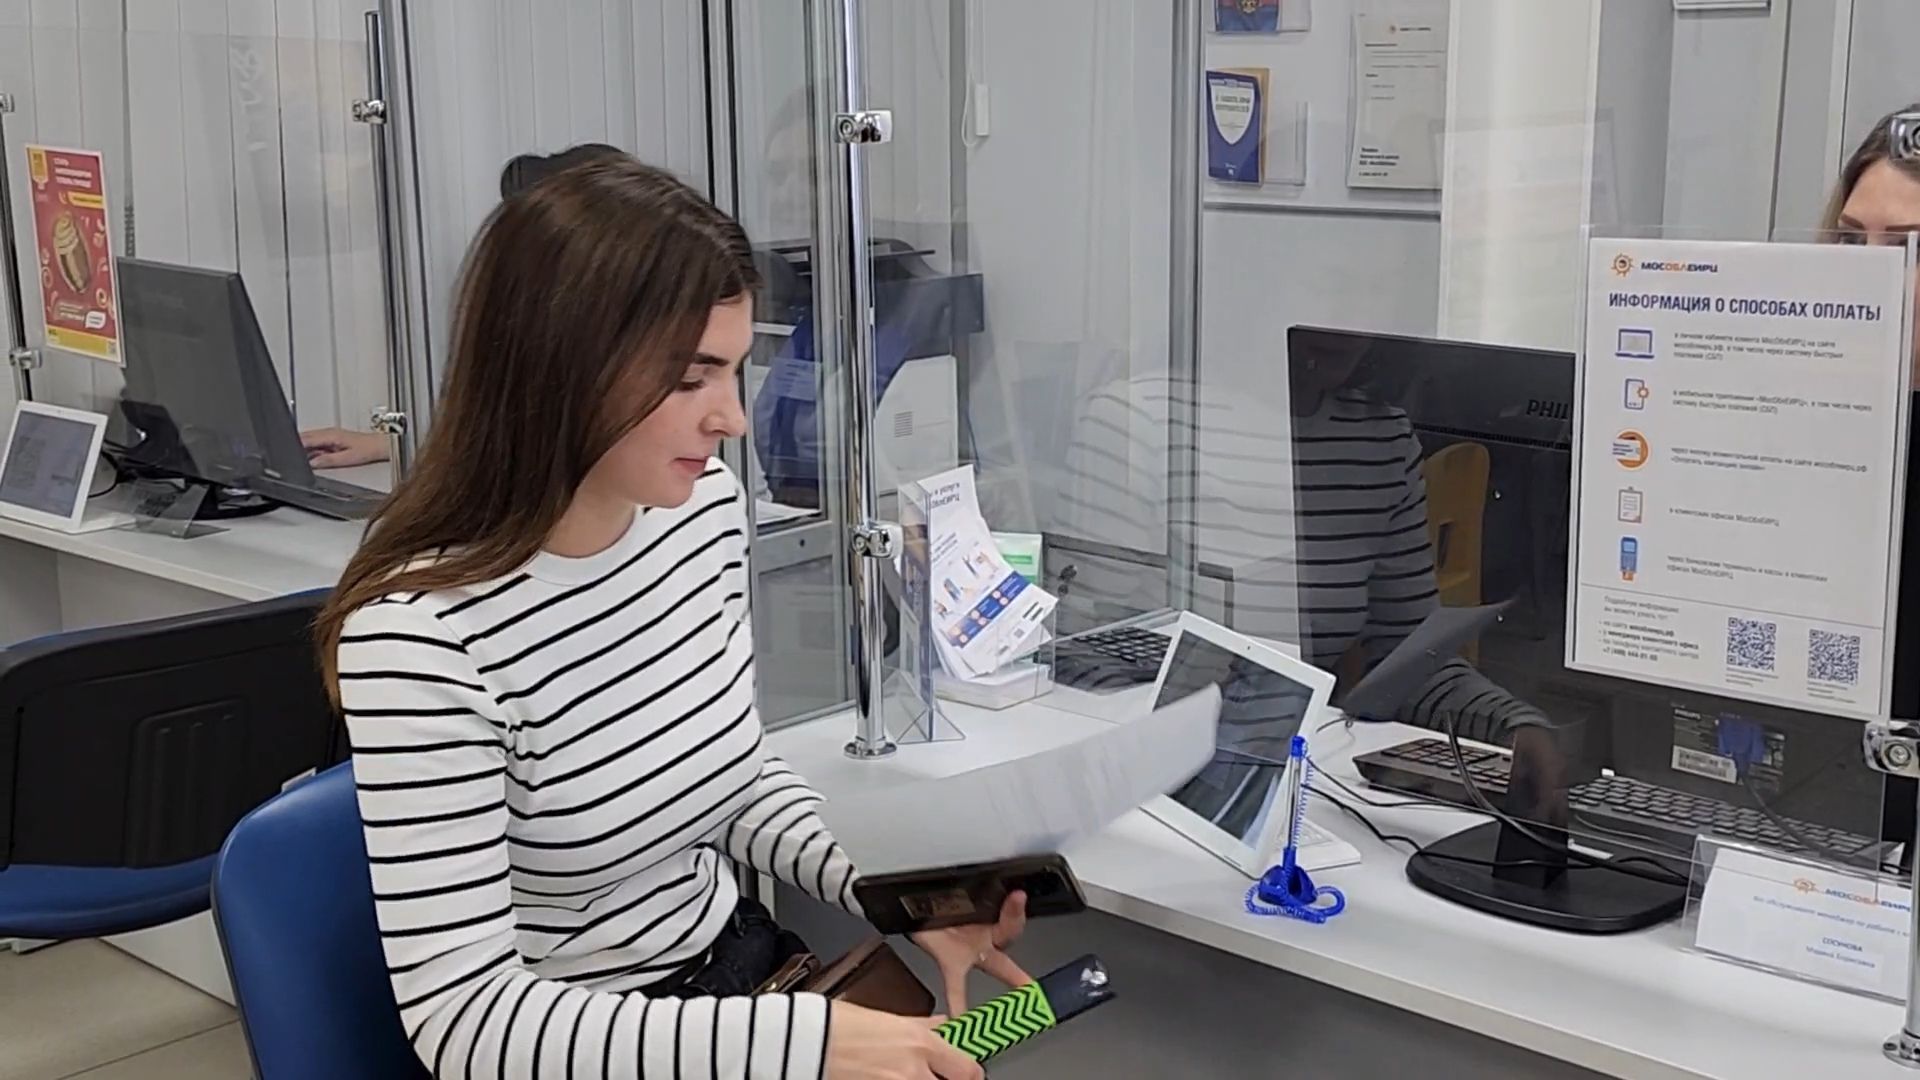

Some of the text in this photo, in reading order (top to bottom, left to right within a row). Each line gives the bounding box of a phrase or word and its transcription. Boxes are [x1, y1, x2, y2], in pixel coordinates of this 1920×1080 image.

[1640, 261, 1719, 274] МОСОБЛЕИРЦ
[1609, 292, 1881, 321] ИНФОРМАЦИЯ О СПОСОБАХ ОПЛАТЫ
[1825, 888, 1911, 912] МОСОБЛЕИР
